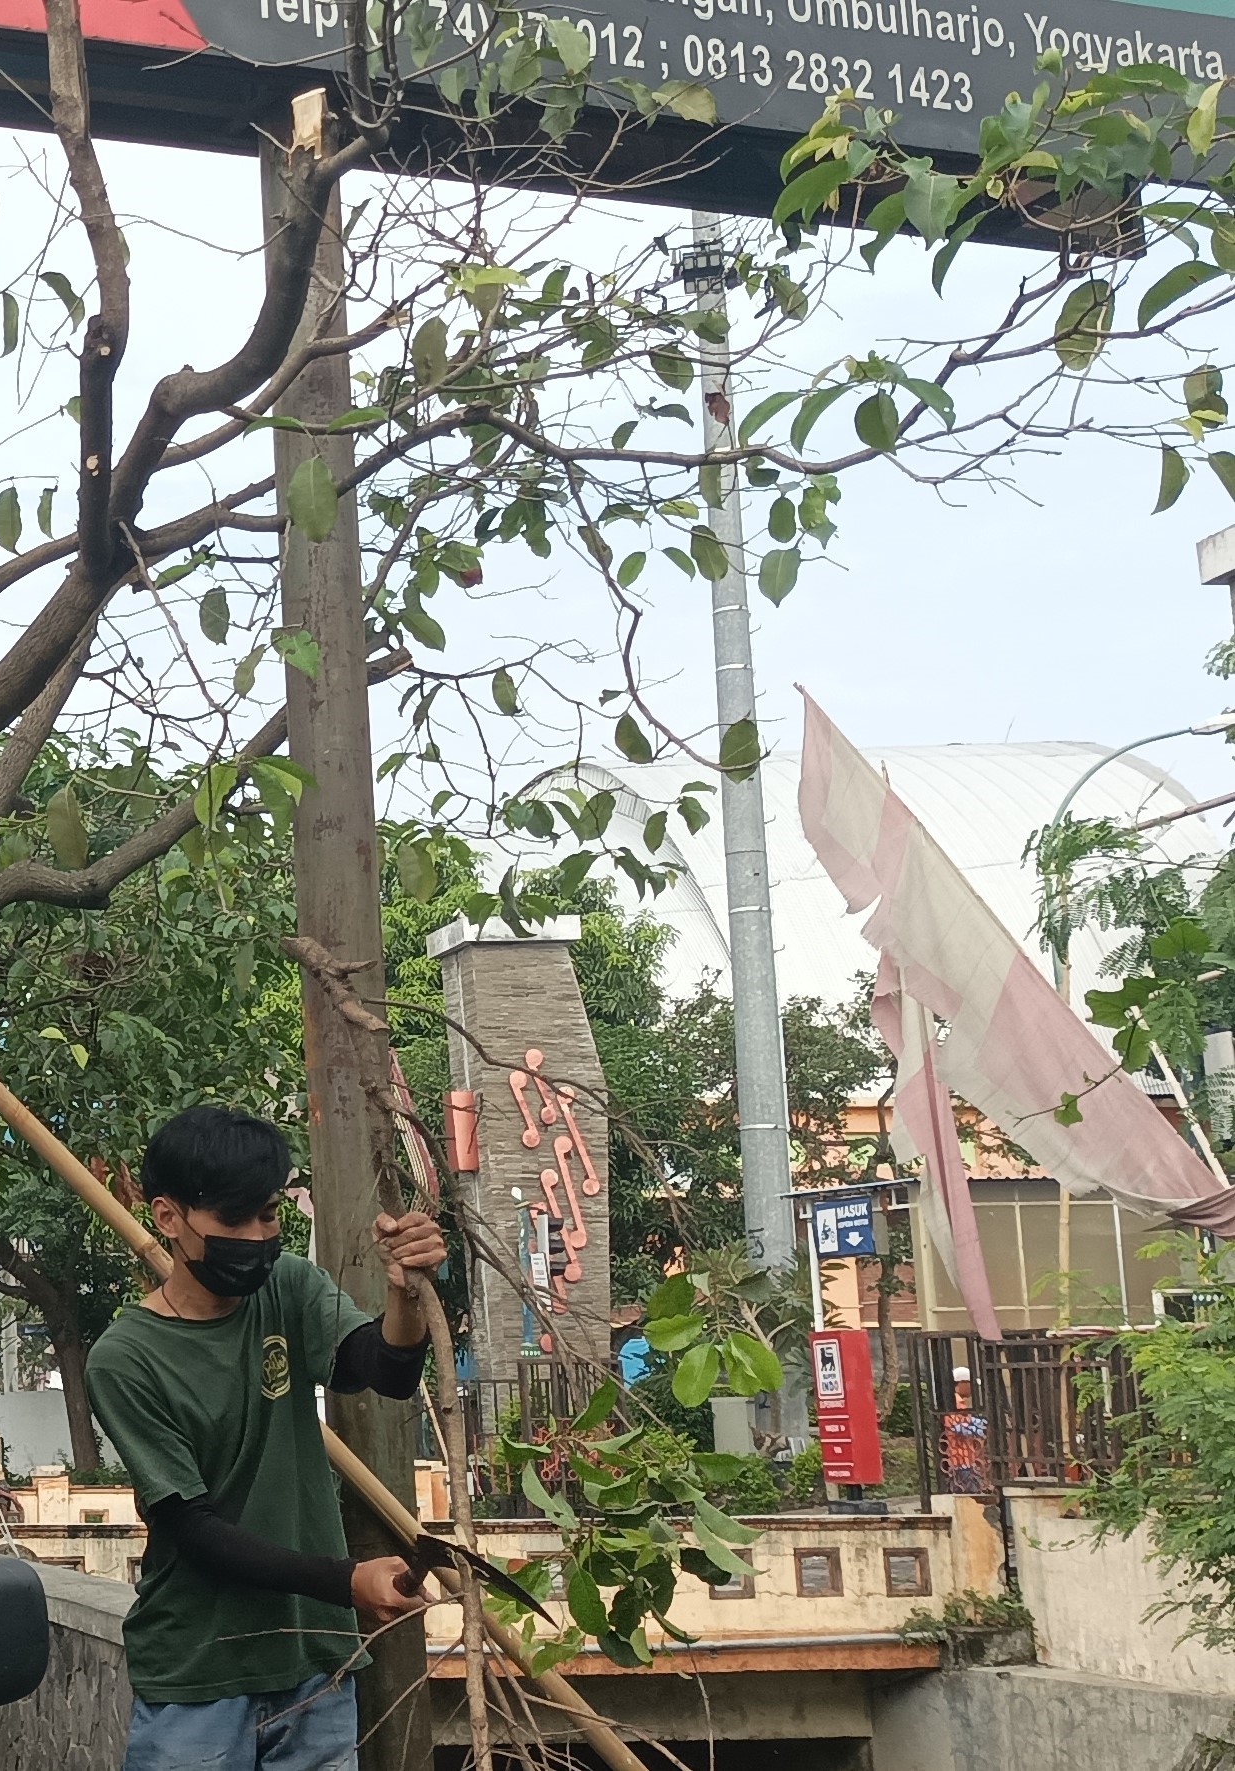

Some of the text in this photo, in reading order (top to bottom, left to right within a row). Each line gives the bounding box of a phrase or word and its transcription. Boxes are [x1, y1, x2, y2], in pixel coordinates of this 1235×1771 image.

[505, 8, 645, 69] 7012
[683, 34, 773, 86] 0813
[785, 49, 874, 100] 2832
[888, 62, 973, 112] 1423
[787, 0, 1015, 57] Umbulharjo,
[1024, 12, 1224, 80] Yogyakarta
